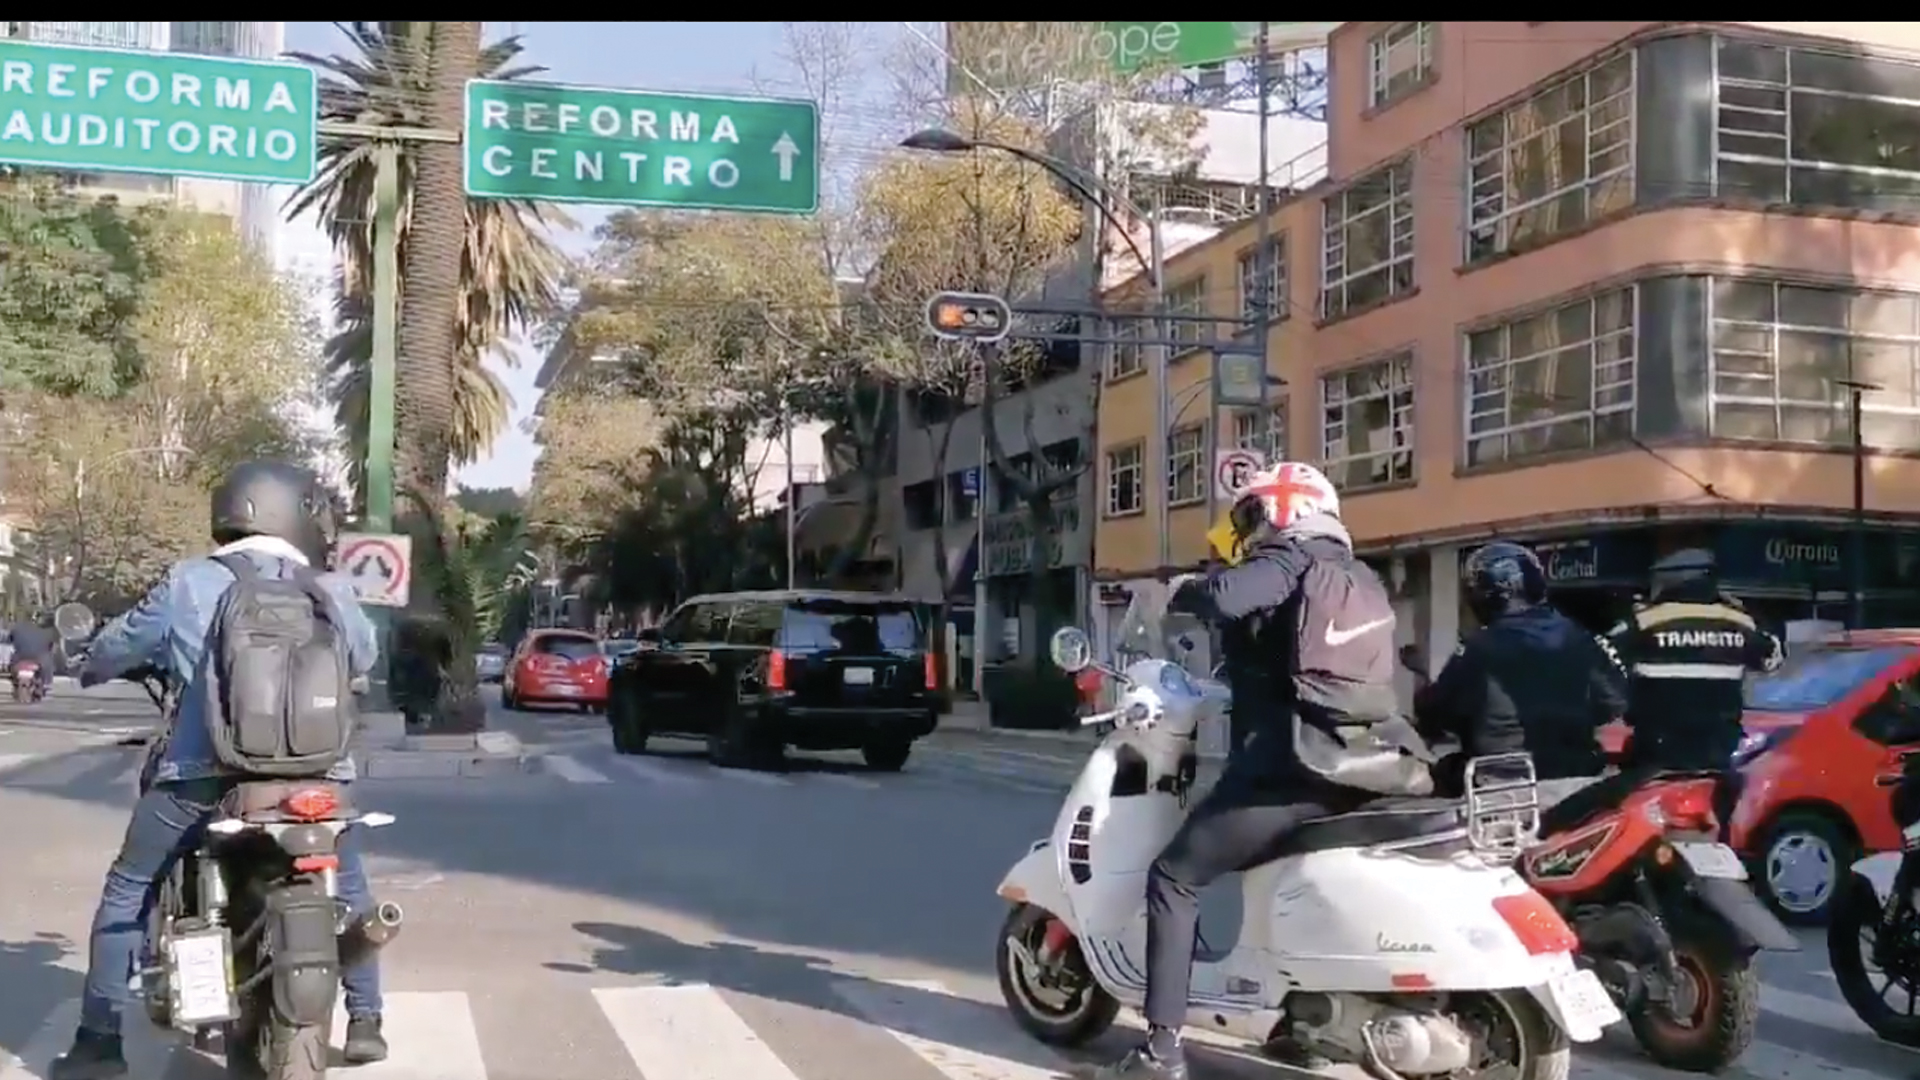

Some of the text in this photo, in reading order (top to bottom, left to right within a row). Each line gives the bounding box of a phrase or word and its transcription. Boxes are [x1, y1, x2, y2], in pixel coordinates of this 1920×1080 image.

[2, 60, 297, 114] REFORMA
[1, 109, 297, 161] AUDITORIO
[482, 99, 740, 144] REFORMA
[482, 145, 740, 189] CENTRO
[1765, 538, 1839, 566] Corona
[1653, 630, 1746, 648] TRANSITO
